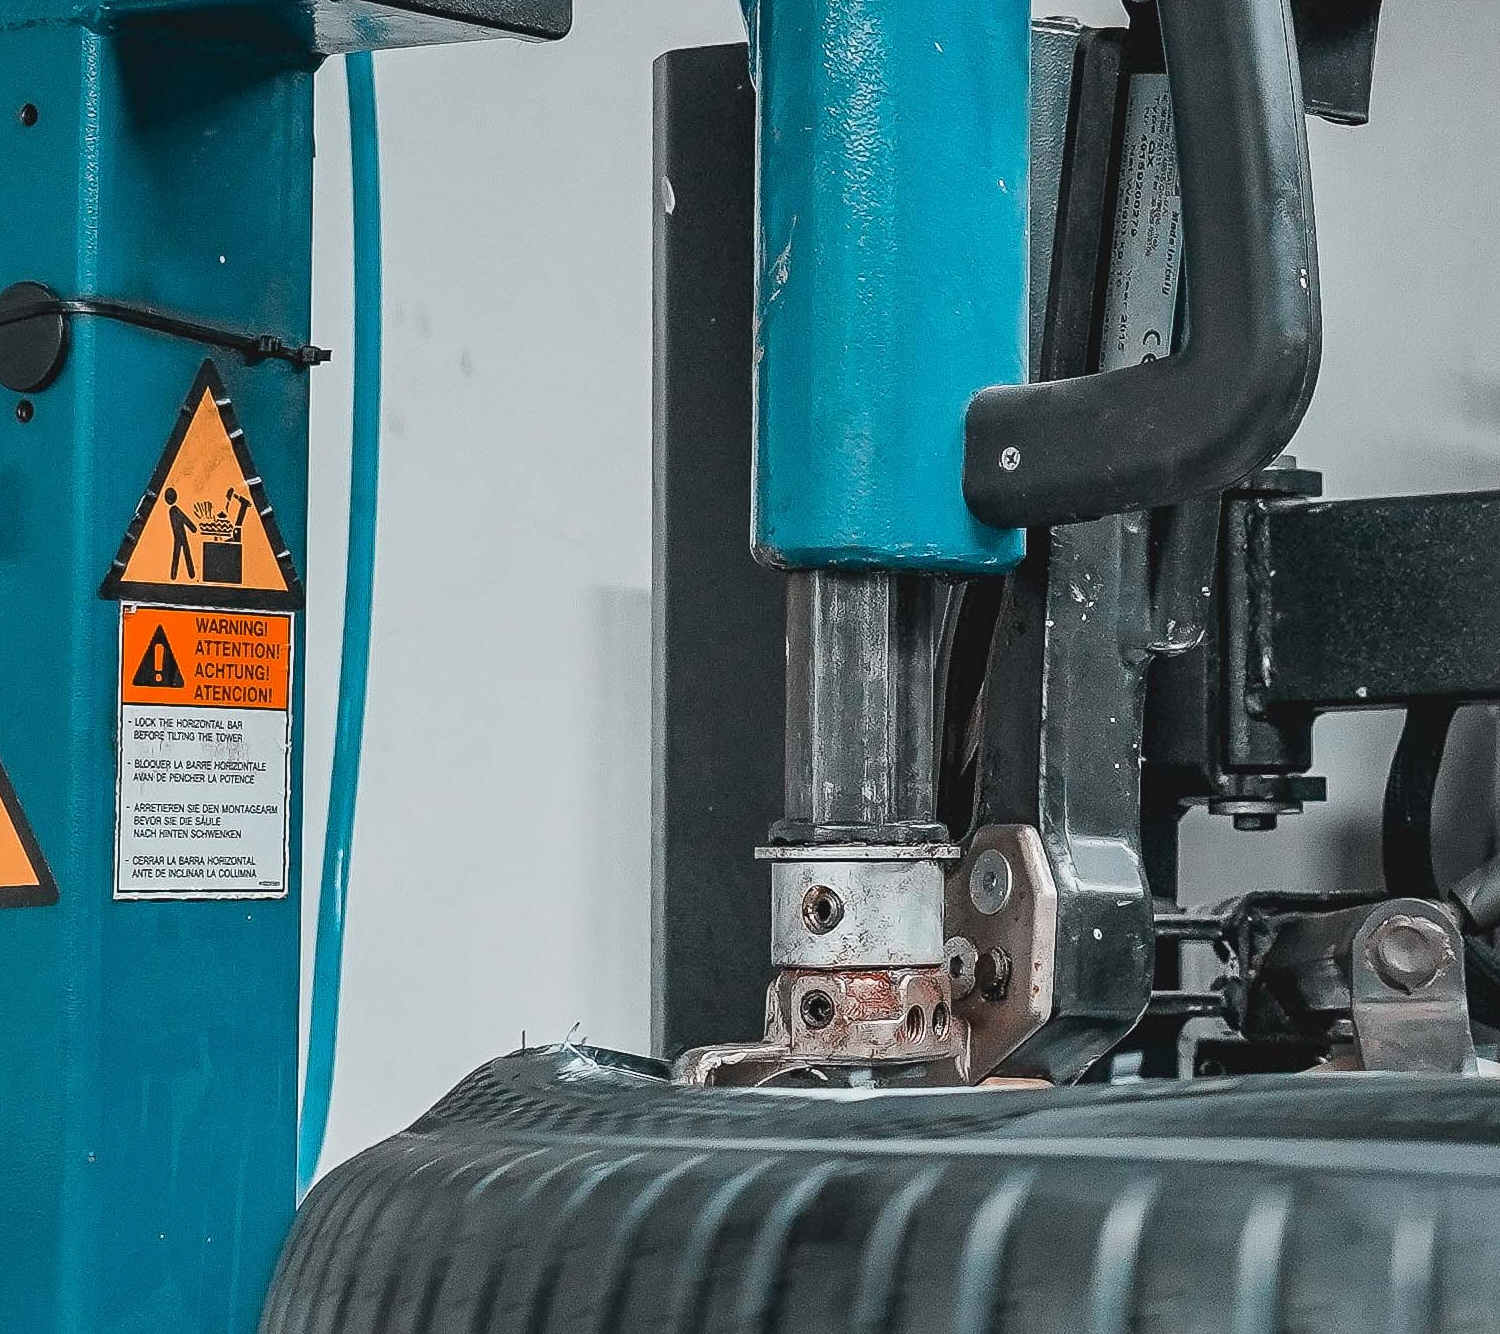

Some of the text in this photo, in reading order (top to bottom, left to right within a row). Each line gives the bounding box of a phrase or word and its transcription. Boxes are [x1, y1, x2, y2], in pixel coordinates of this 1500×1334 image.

[196, 616, 270, 637] WARNING!
[195, 640, 279, 659] ATTENTION!
[195, 663, 269, 681] ACHTUNG!
[194, 685, 272, 703] ATENCION!
